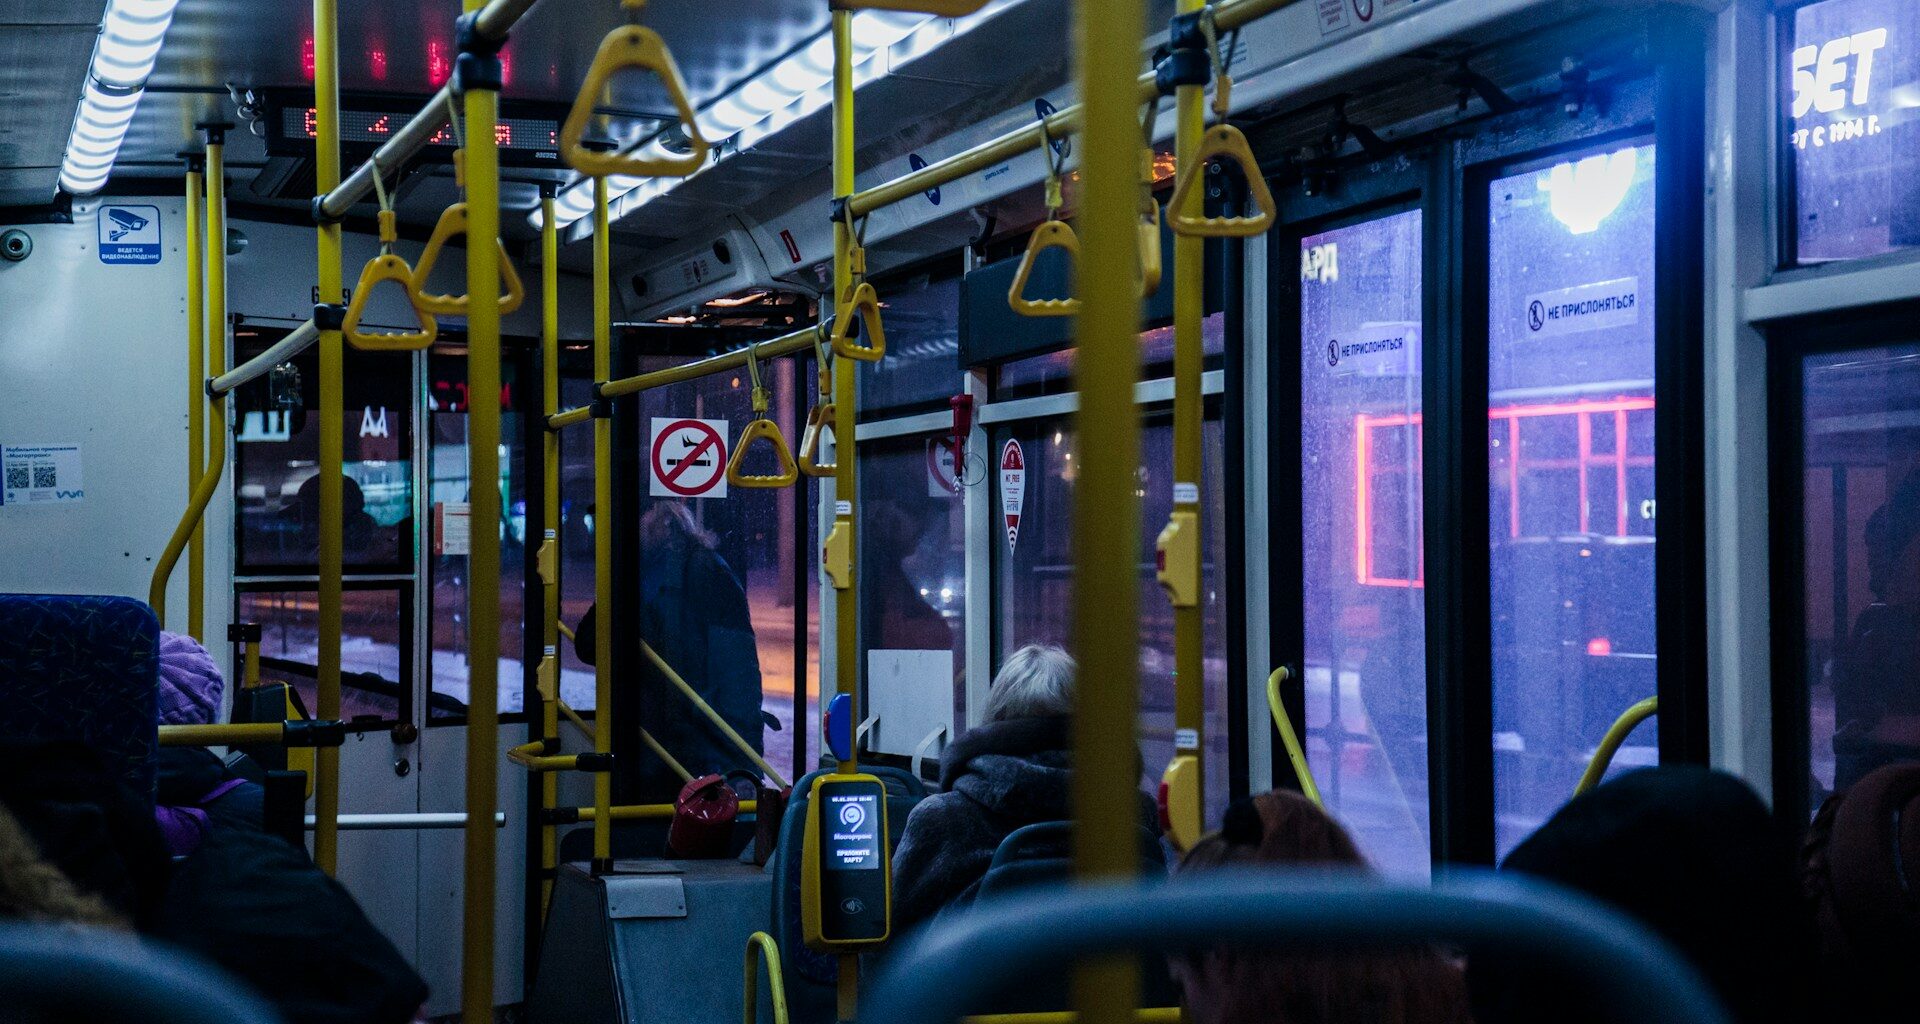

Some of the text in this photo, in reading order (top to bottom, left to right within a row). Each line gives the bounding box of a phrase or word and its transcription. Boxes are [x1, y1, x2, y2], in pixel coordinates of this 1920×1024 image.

[1829, 118, 1864, 143] 1994
[1548, 293, 1635, 320] НЕ ПРИСЛОНЯТЬСЯ
[1341, 337, 1403, 357] НЕ ПРИСЛОНЯТЬСЯ
